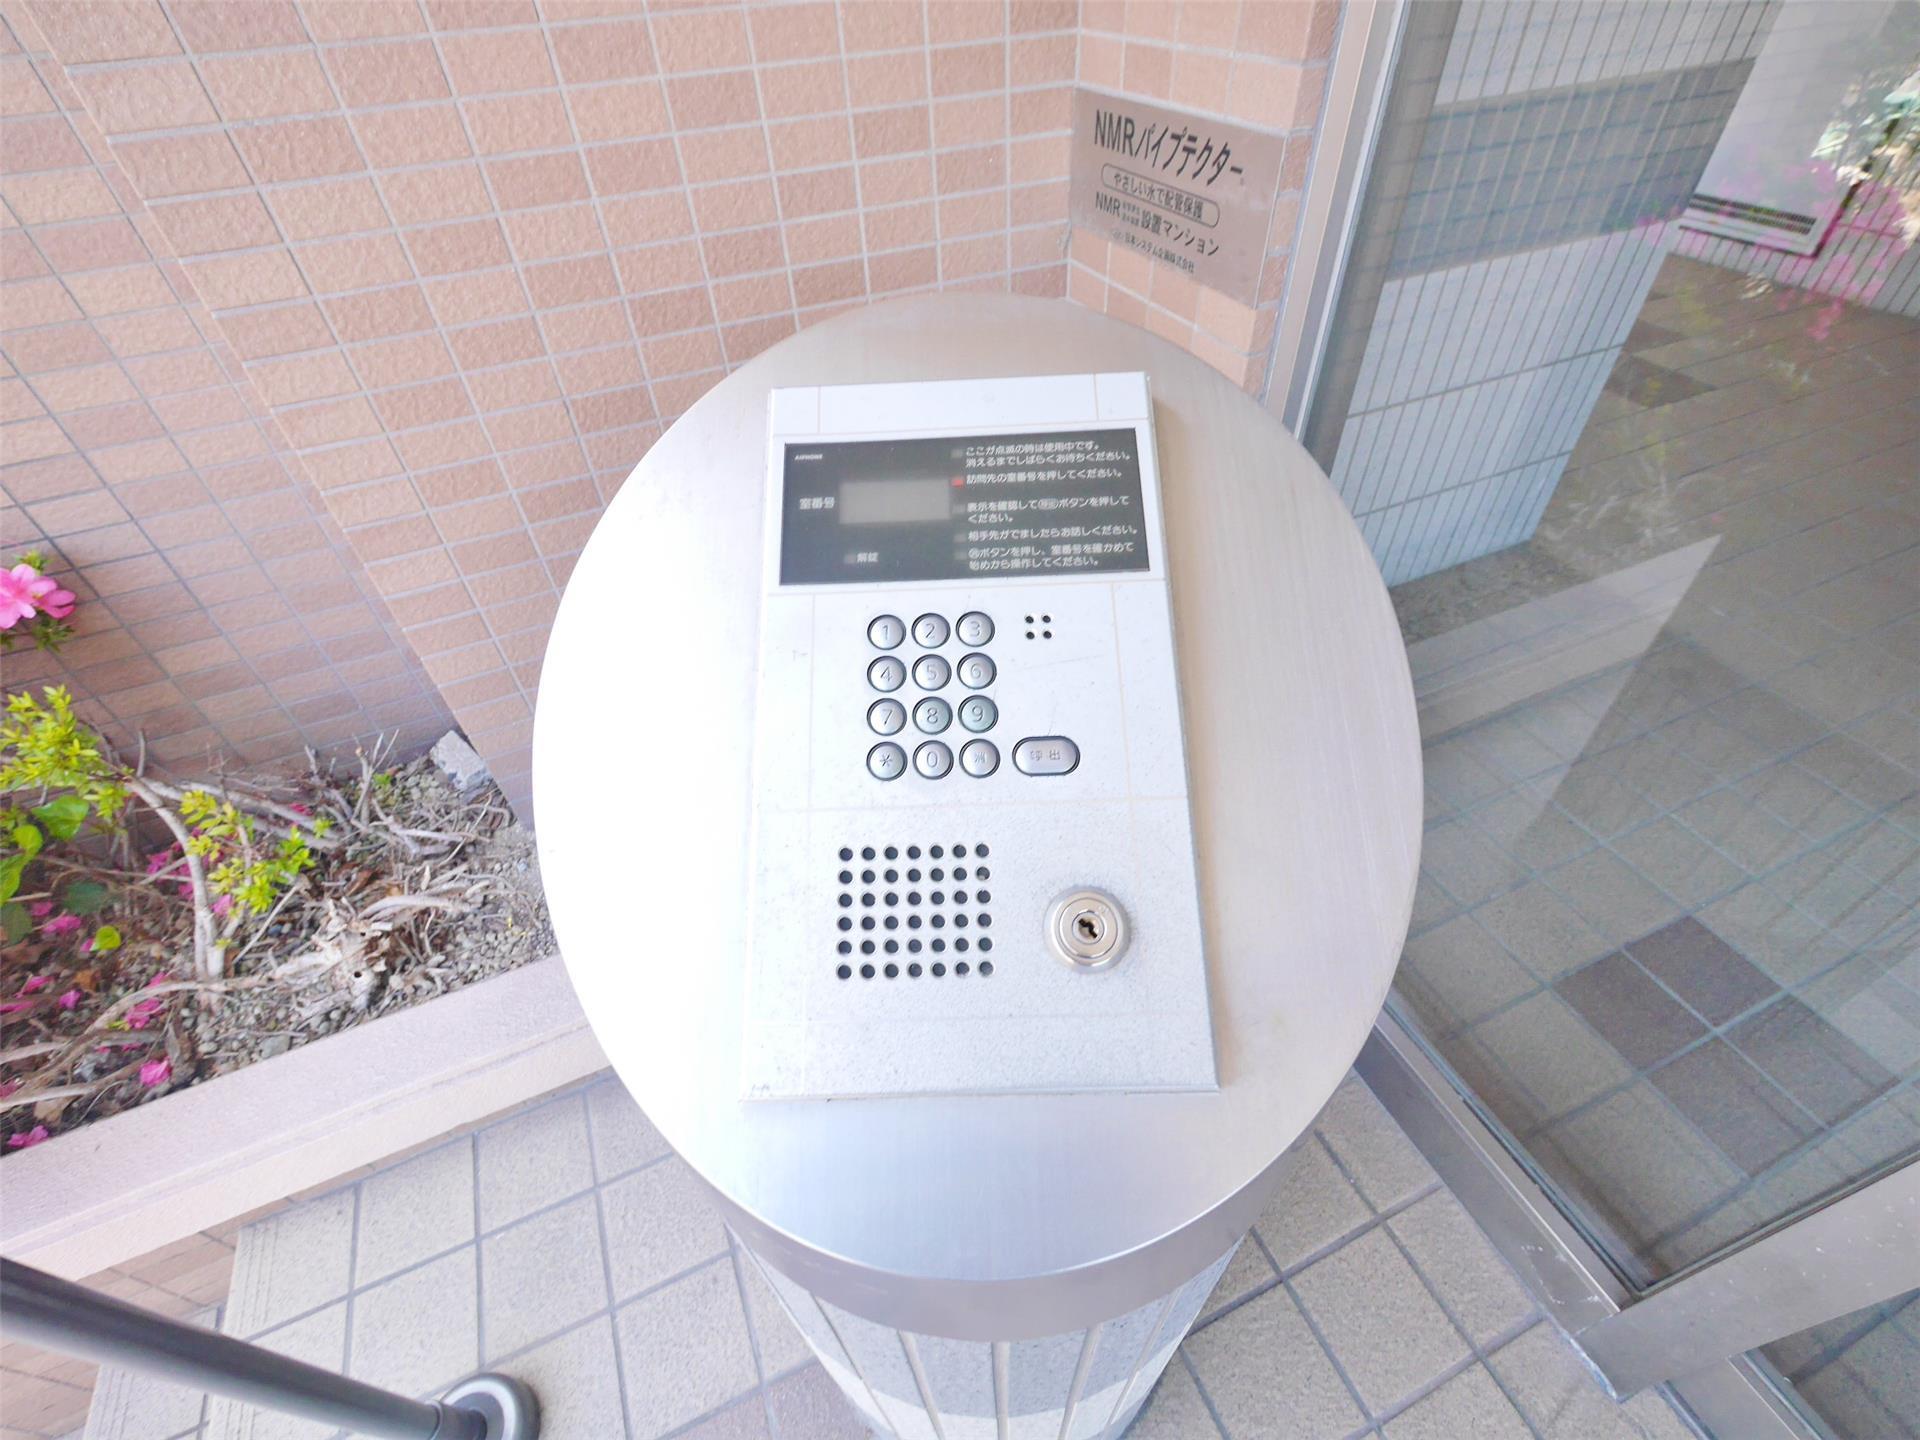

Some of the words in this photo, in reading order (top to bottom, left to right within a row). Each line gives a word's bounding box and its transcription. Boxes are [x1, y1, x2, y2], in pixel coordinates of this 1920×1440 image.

[1094, 109, 1243, 186] NMRパイプテクター
[881, 624, 890, 641] 1
[925, 623, 936, 639] 2
[970, 621, 981, 637] 3
[880, 666, 893, 682] 4
[926, 664, 937, 681] 5
[970, 664, 982, 679] 6
[882, 708, 893, 726] 7
[926, 707, 938, 725] 8
[971, 705, 984, 723] 9
[926, 751, 938, 768] 0
